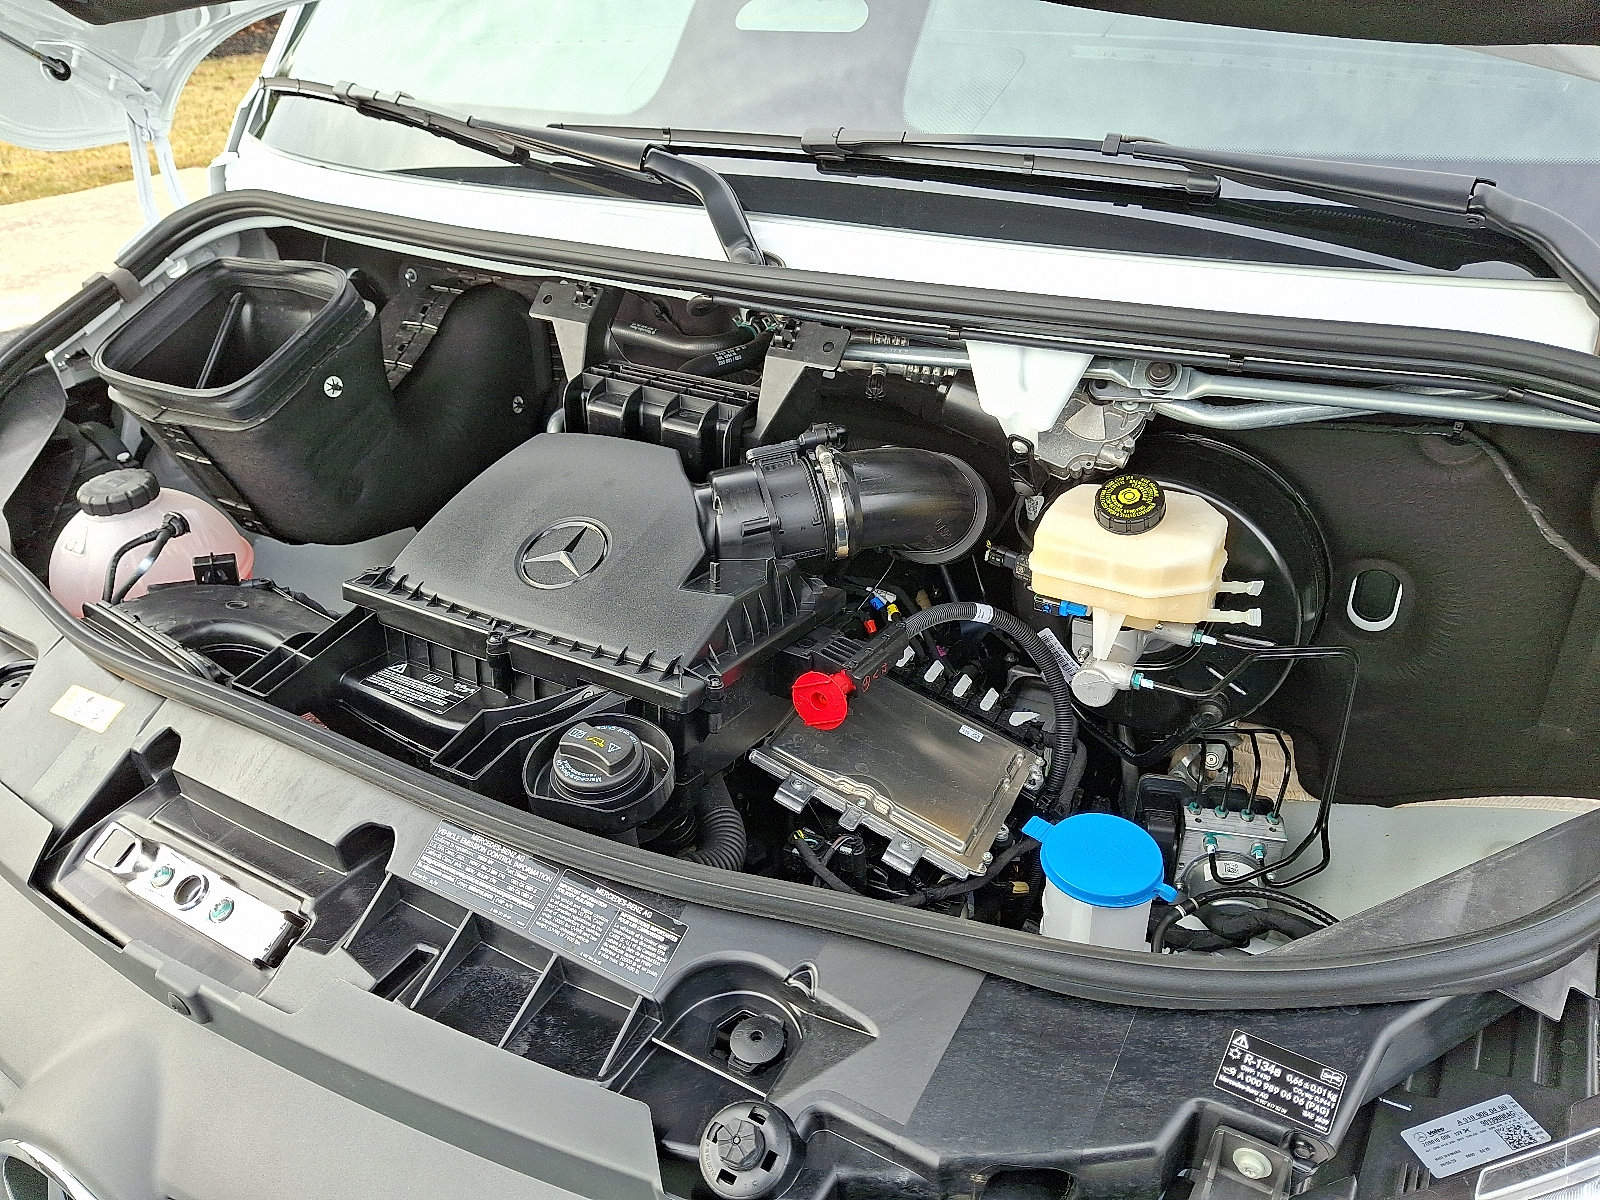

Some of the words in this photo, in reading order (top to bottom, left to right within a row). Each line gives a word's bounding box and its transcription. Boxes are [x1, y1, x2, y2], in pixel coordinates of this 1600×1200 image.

[437, 827, 461, 841] VEHICLE
[460, 837, 487, 853] EMISSION
[486, 848, 514, 864] CONTROL
[514, 860, 554, 881] INFORMATION
[471, 834, 516, 858] MERCEDES-BENZ
[516, 853, 526, 862] AG
[595, 887, 643, 914] MERCEDES-BENZ
[642, 909, 653, 918] AG
[1219, 1074, 1259, 1095] Mercedes-Benz
[1259, 1091, 1269, 1100] AG
[1243, 1054, 1282, 1077] R-134a
[1286, 1074, 1303, 1088] 0,66
[1309, 1084, 1327, 1097] 0,01
[1327, 1091, 1338, 1102] kg
[1237, 1072, 1245, 1080] A
[1245, 1075, 1262, 1088] 000
[1262, 1082, 1279, 1095] 989
[1280, 1090, 1292, 1100] 06
[1293, 1095, 1305, 1106] 06
[1305, 1100, 1330, 1118] (PAG)
[1427, 1127, 1446, 1136] Valeo
